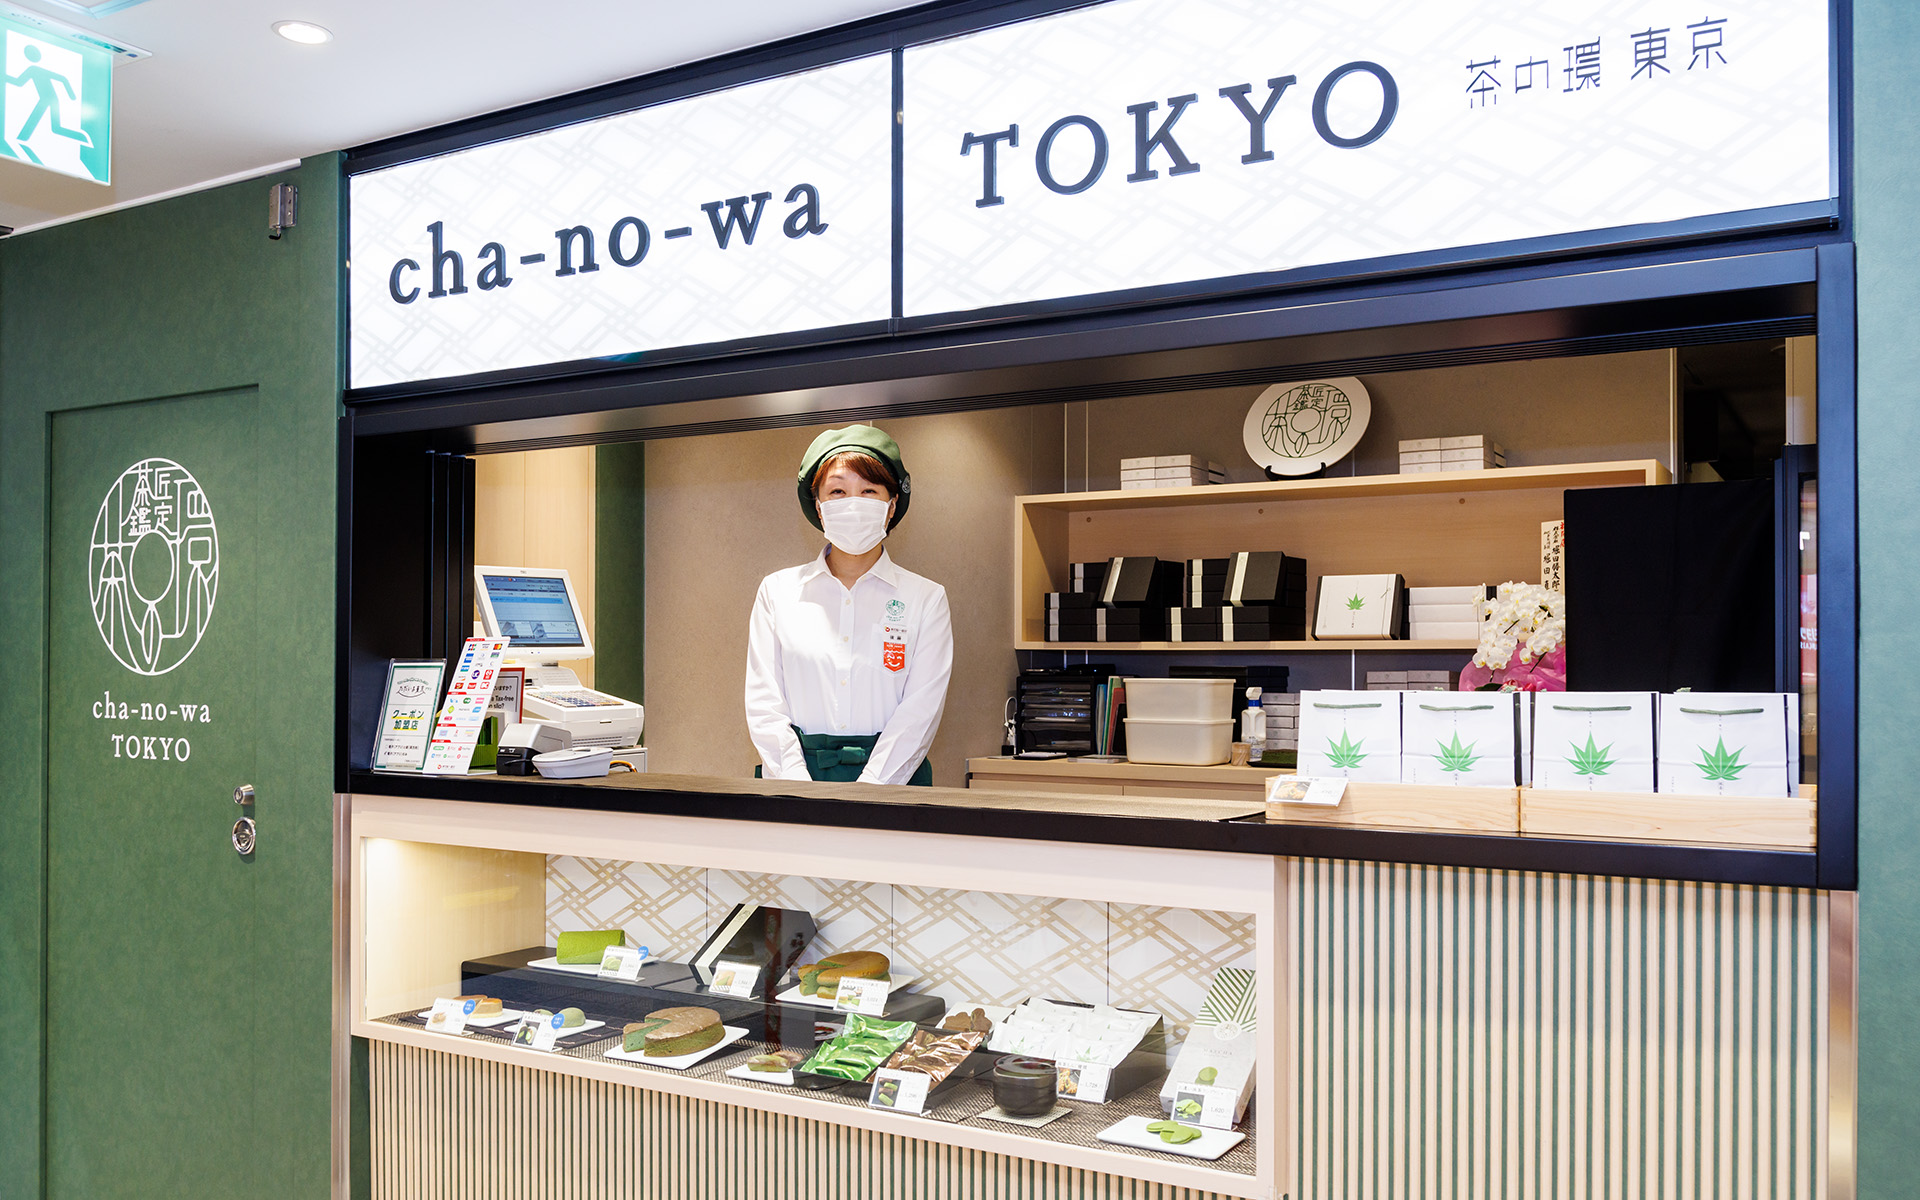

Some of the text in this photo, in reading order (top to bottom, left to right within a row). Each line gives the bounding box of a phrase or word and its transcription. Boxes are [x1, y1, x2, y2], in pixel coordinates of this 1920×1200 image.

[1466, 17, 1727, 108] 茶の環 東京
[390, 61, 1398, 304] cha-no-wa TOKYO
[93, 691, 211, 722] cha-no-wa
[392, 709, 425, 719] クーポン
[394, 719, 419, 730] 加盟店
[112, 734, 190, 761] TOKYO
